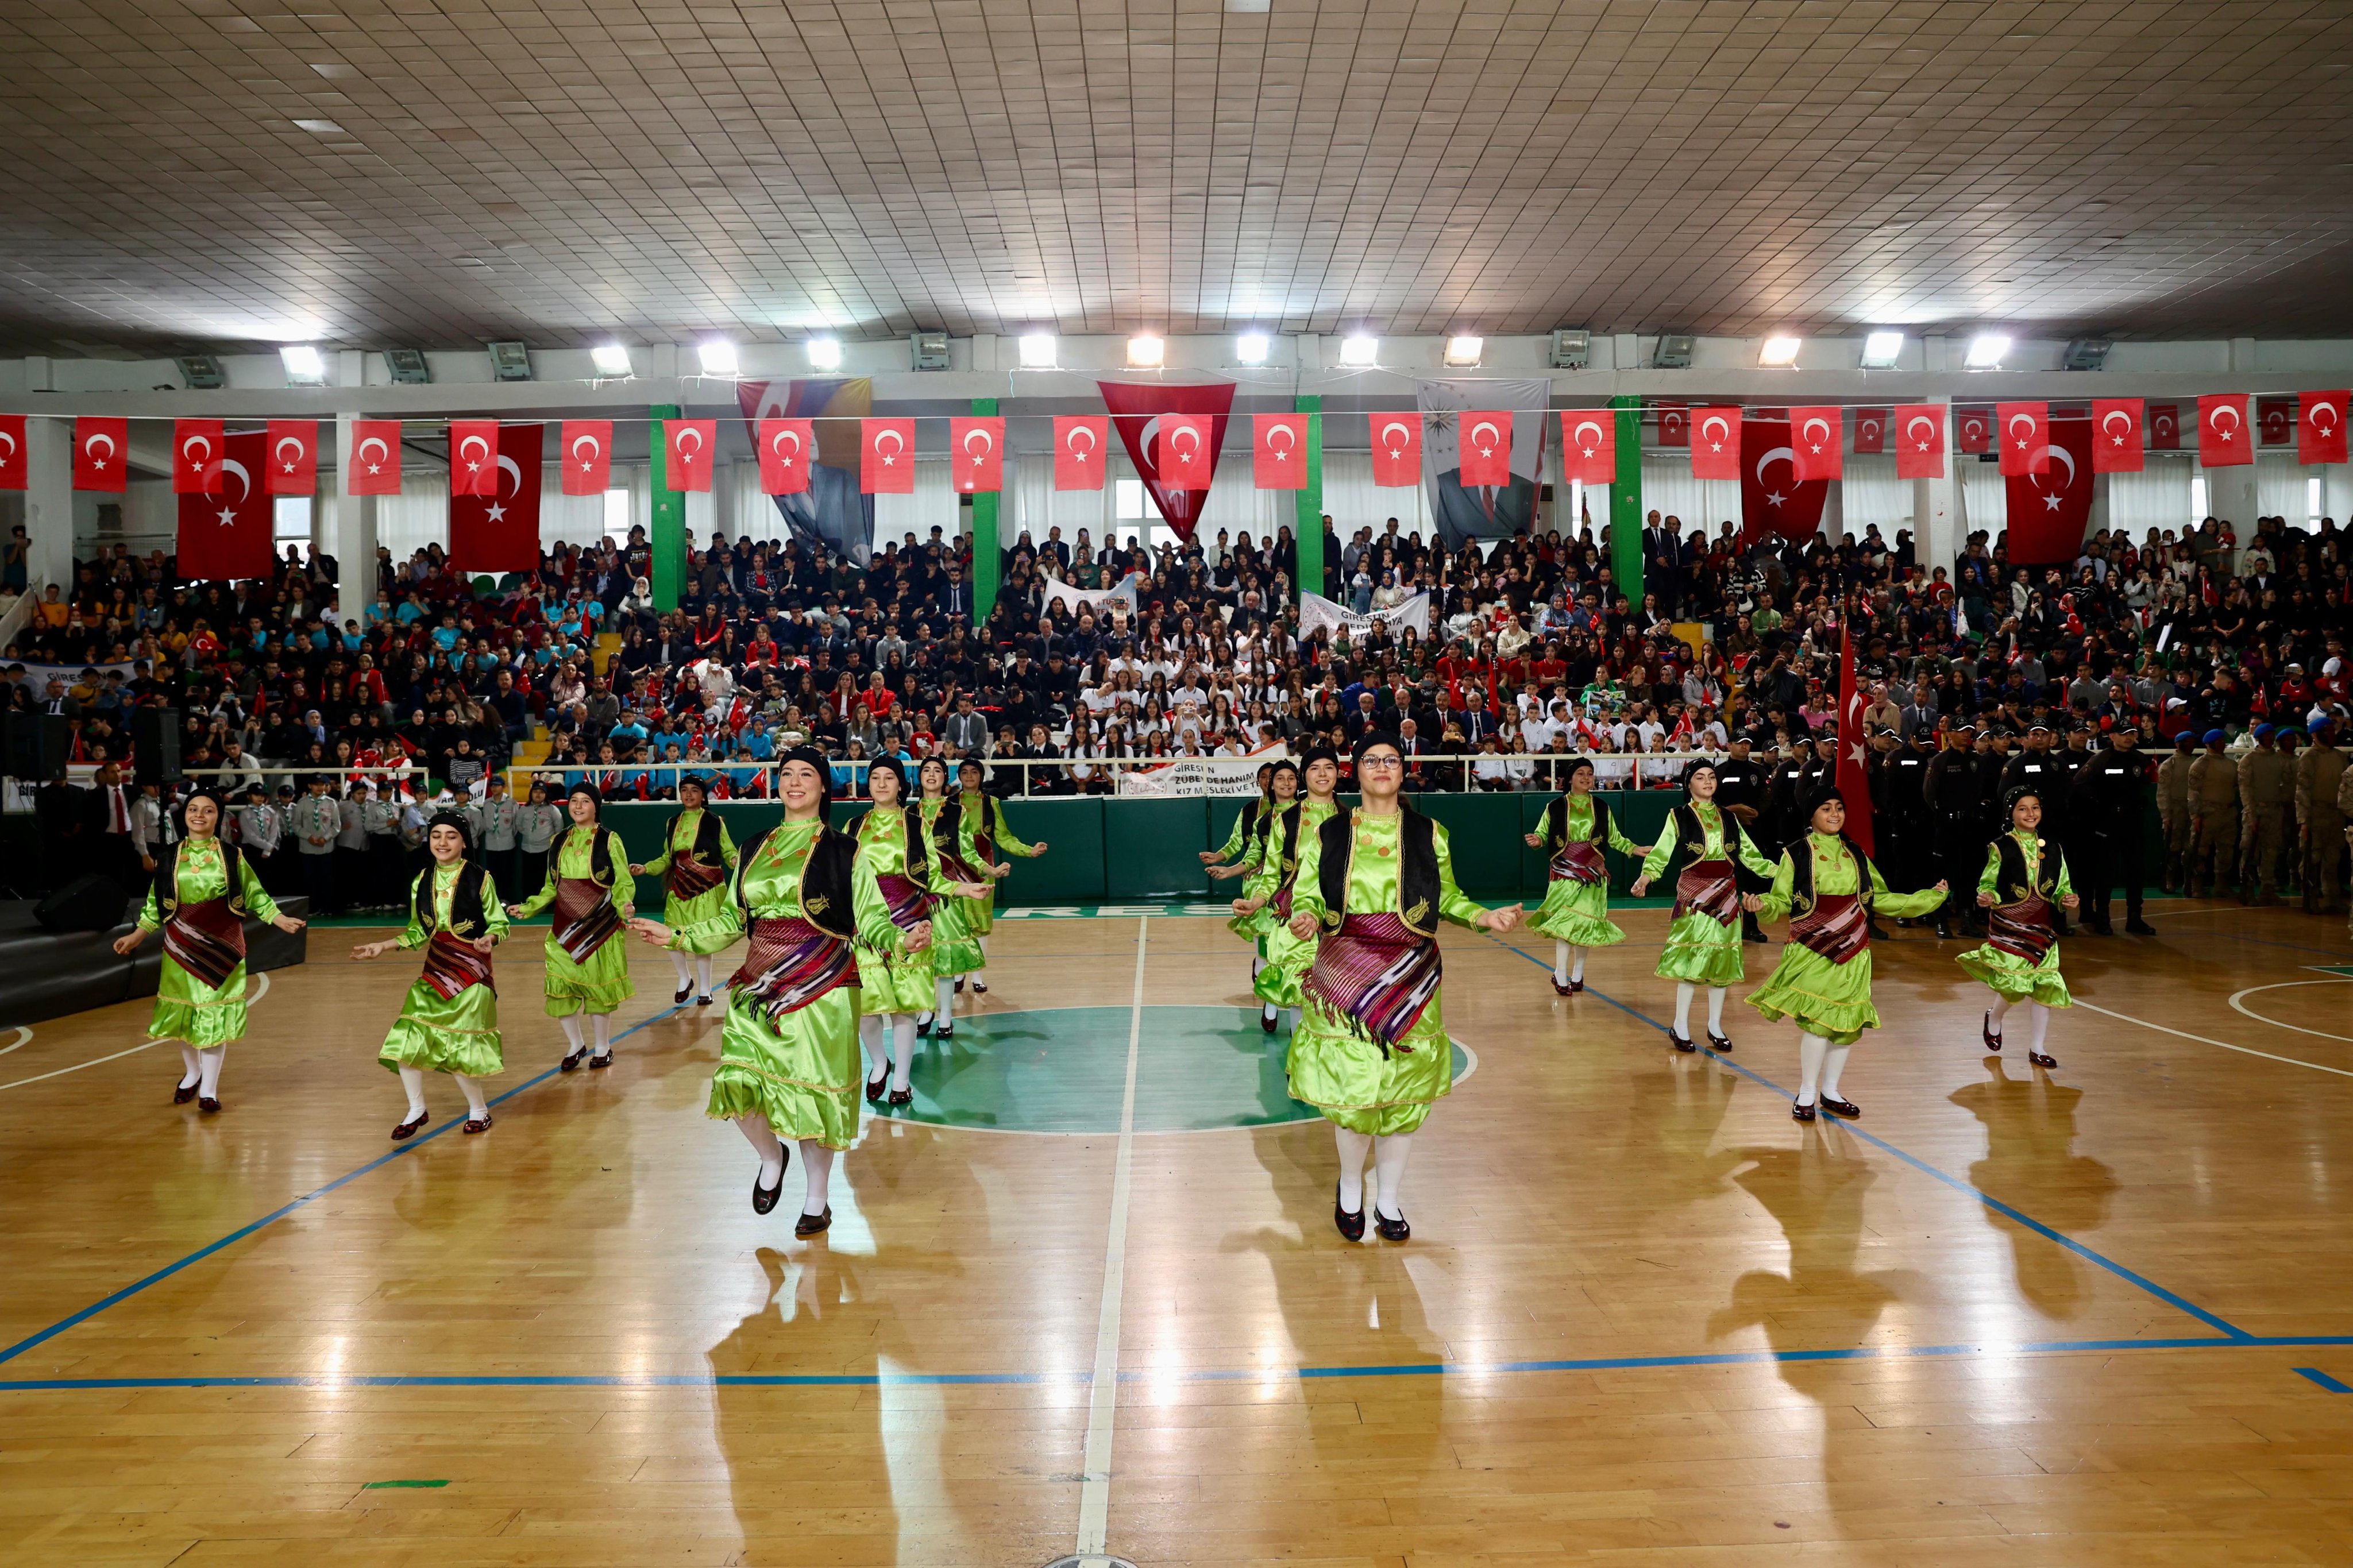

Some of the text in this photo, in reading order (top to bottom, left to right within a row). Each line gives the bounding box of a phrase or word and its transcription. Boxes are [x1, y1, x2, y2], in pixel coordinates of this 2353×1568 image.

[47, 671, 106, 682] GİRESN
[1174, 763, 1214, 774] GİRESN
[1175, 772, 1255, 785] ZÜBEDE HANIM
[1236, 783, 1249, 792] VE
